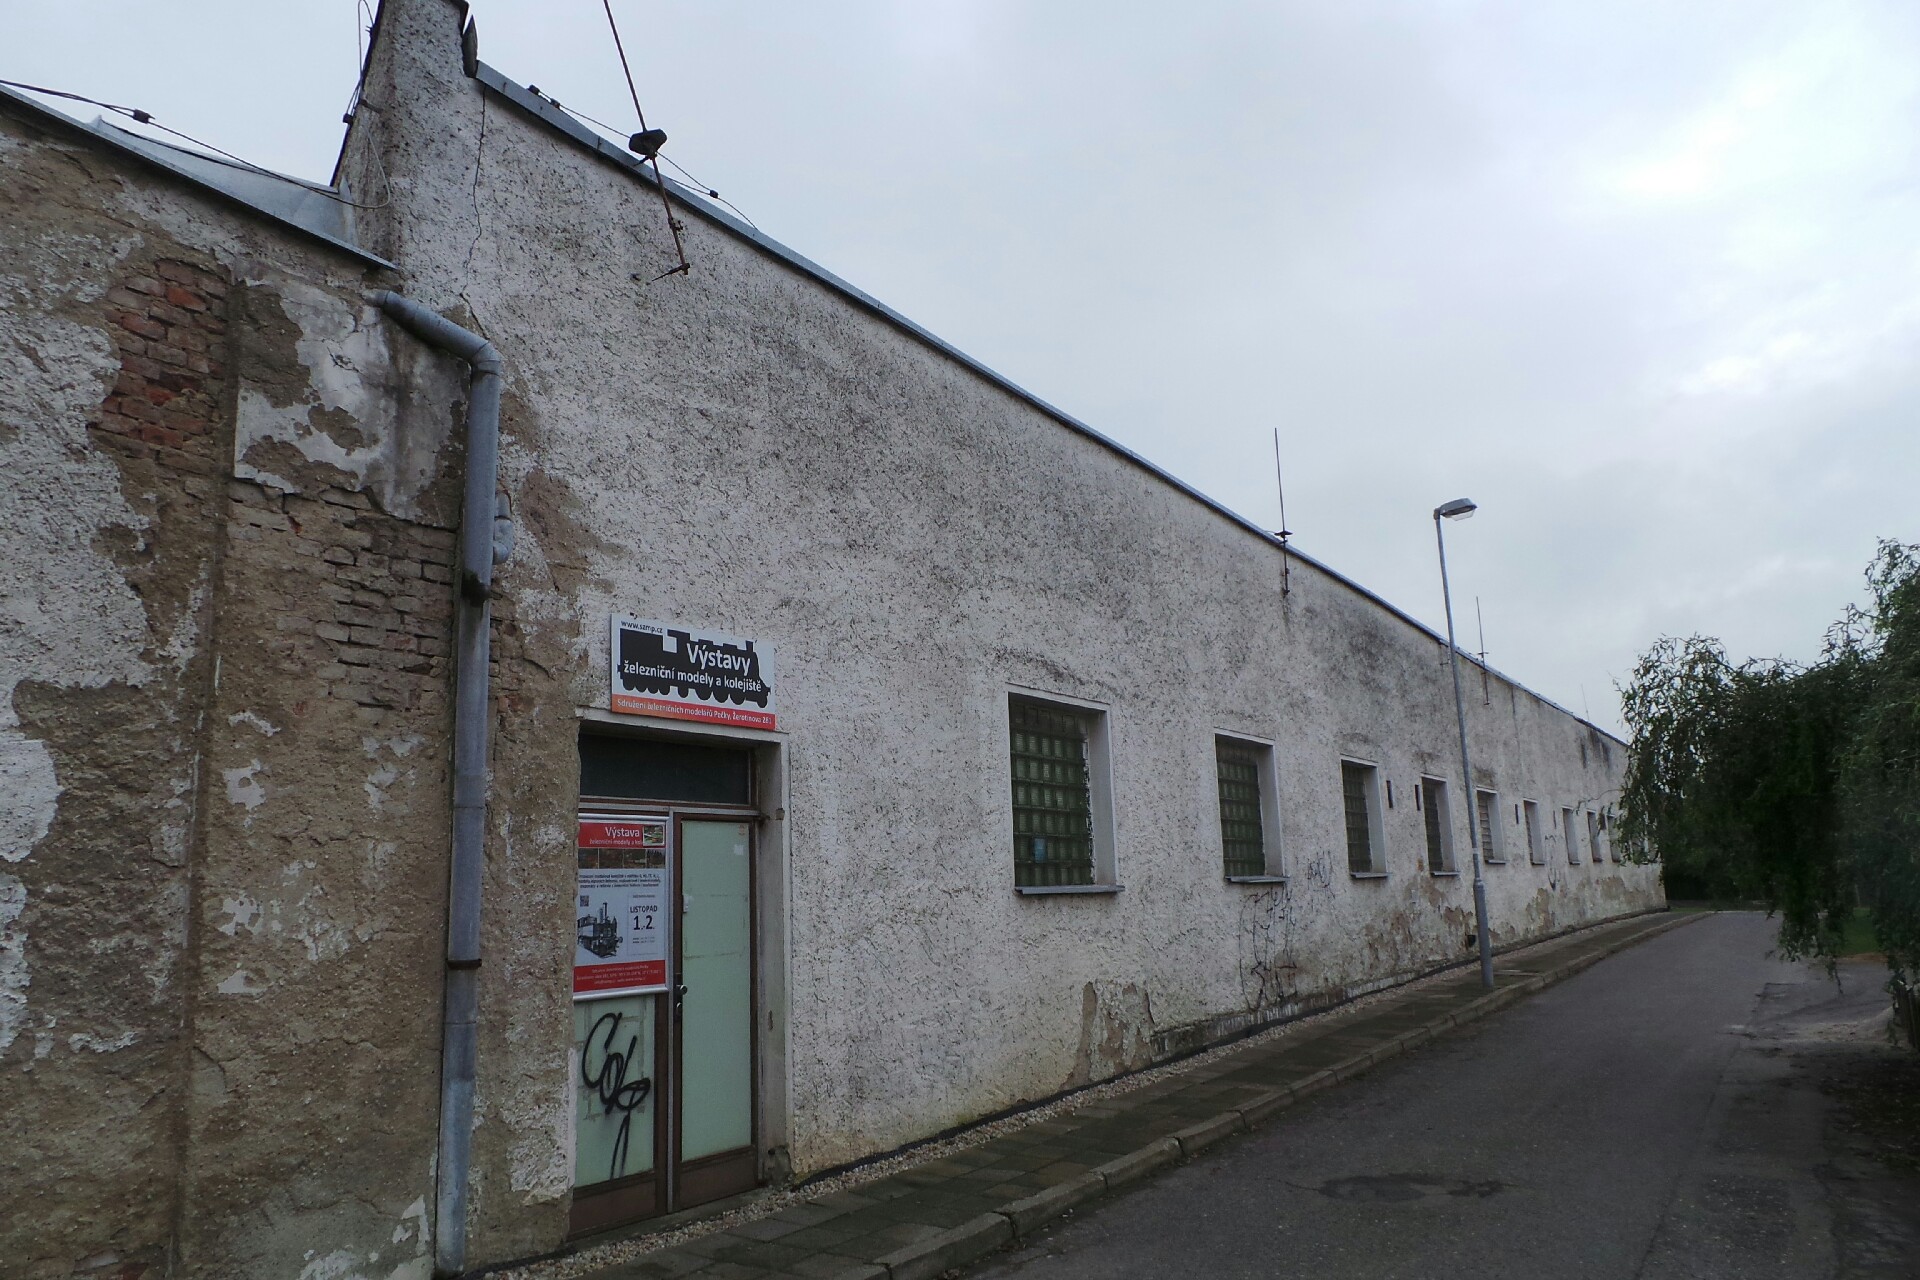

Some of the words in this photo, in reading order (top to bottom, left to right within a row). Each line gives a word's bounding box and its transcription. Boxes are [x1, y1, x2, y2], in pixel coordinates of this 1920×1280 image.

[620, 621, 663, 633] www.szmp.cz
[686, 642, 751, 677] Výstavy
[623, 659, 676, 680] železniční
[677, 671, 714, 688] modely
[715, 677, 722, 686] a
[724, 675, 762, 693] kolejiště
[604, 826, 640, 839] Výstava
[629, 904, 658, 914] LISTOPAD
